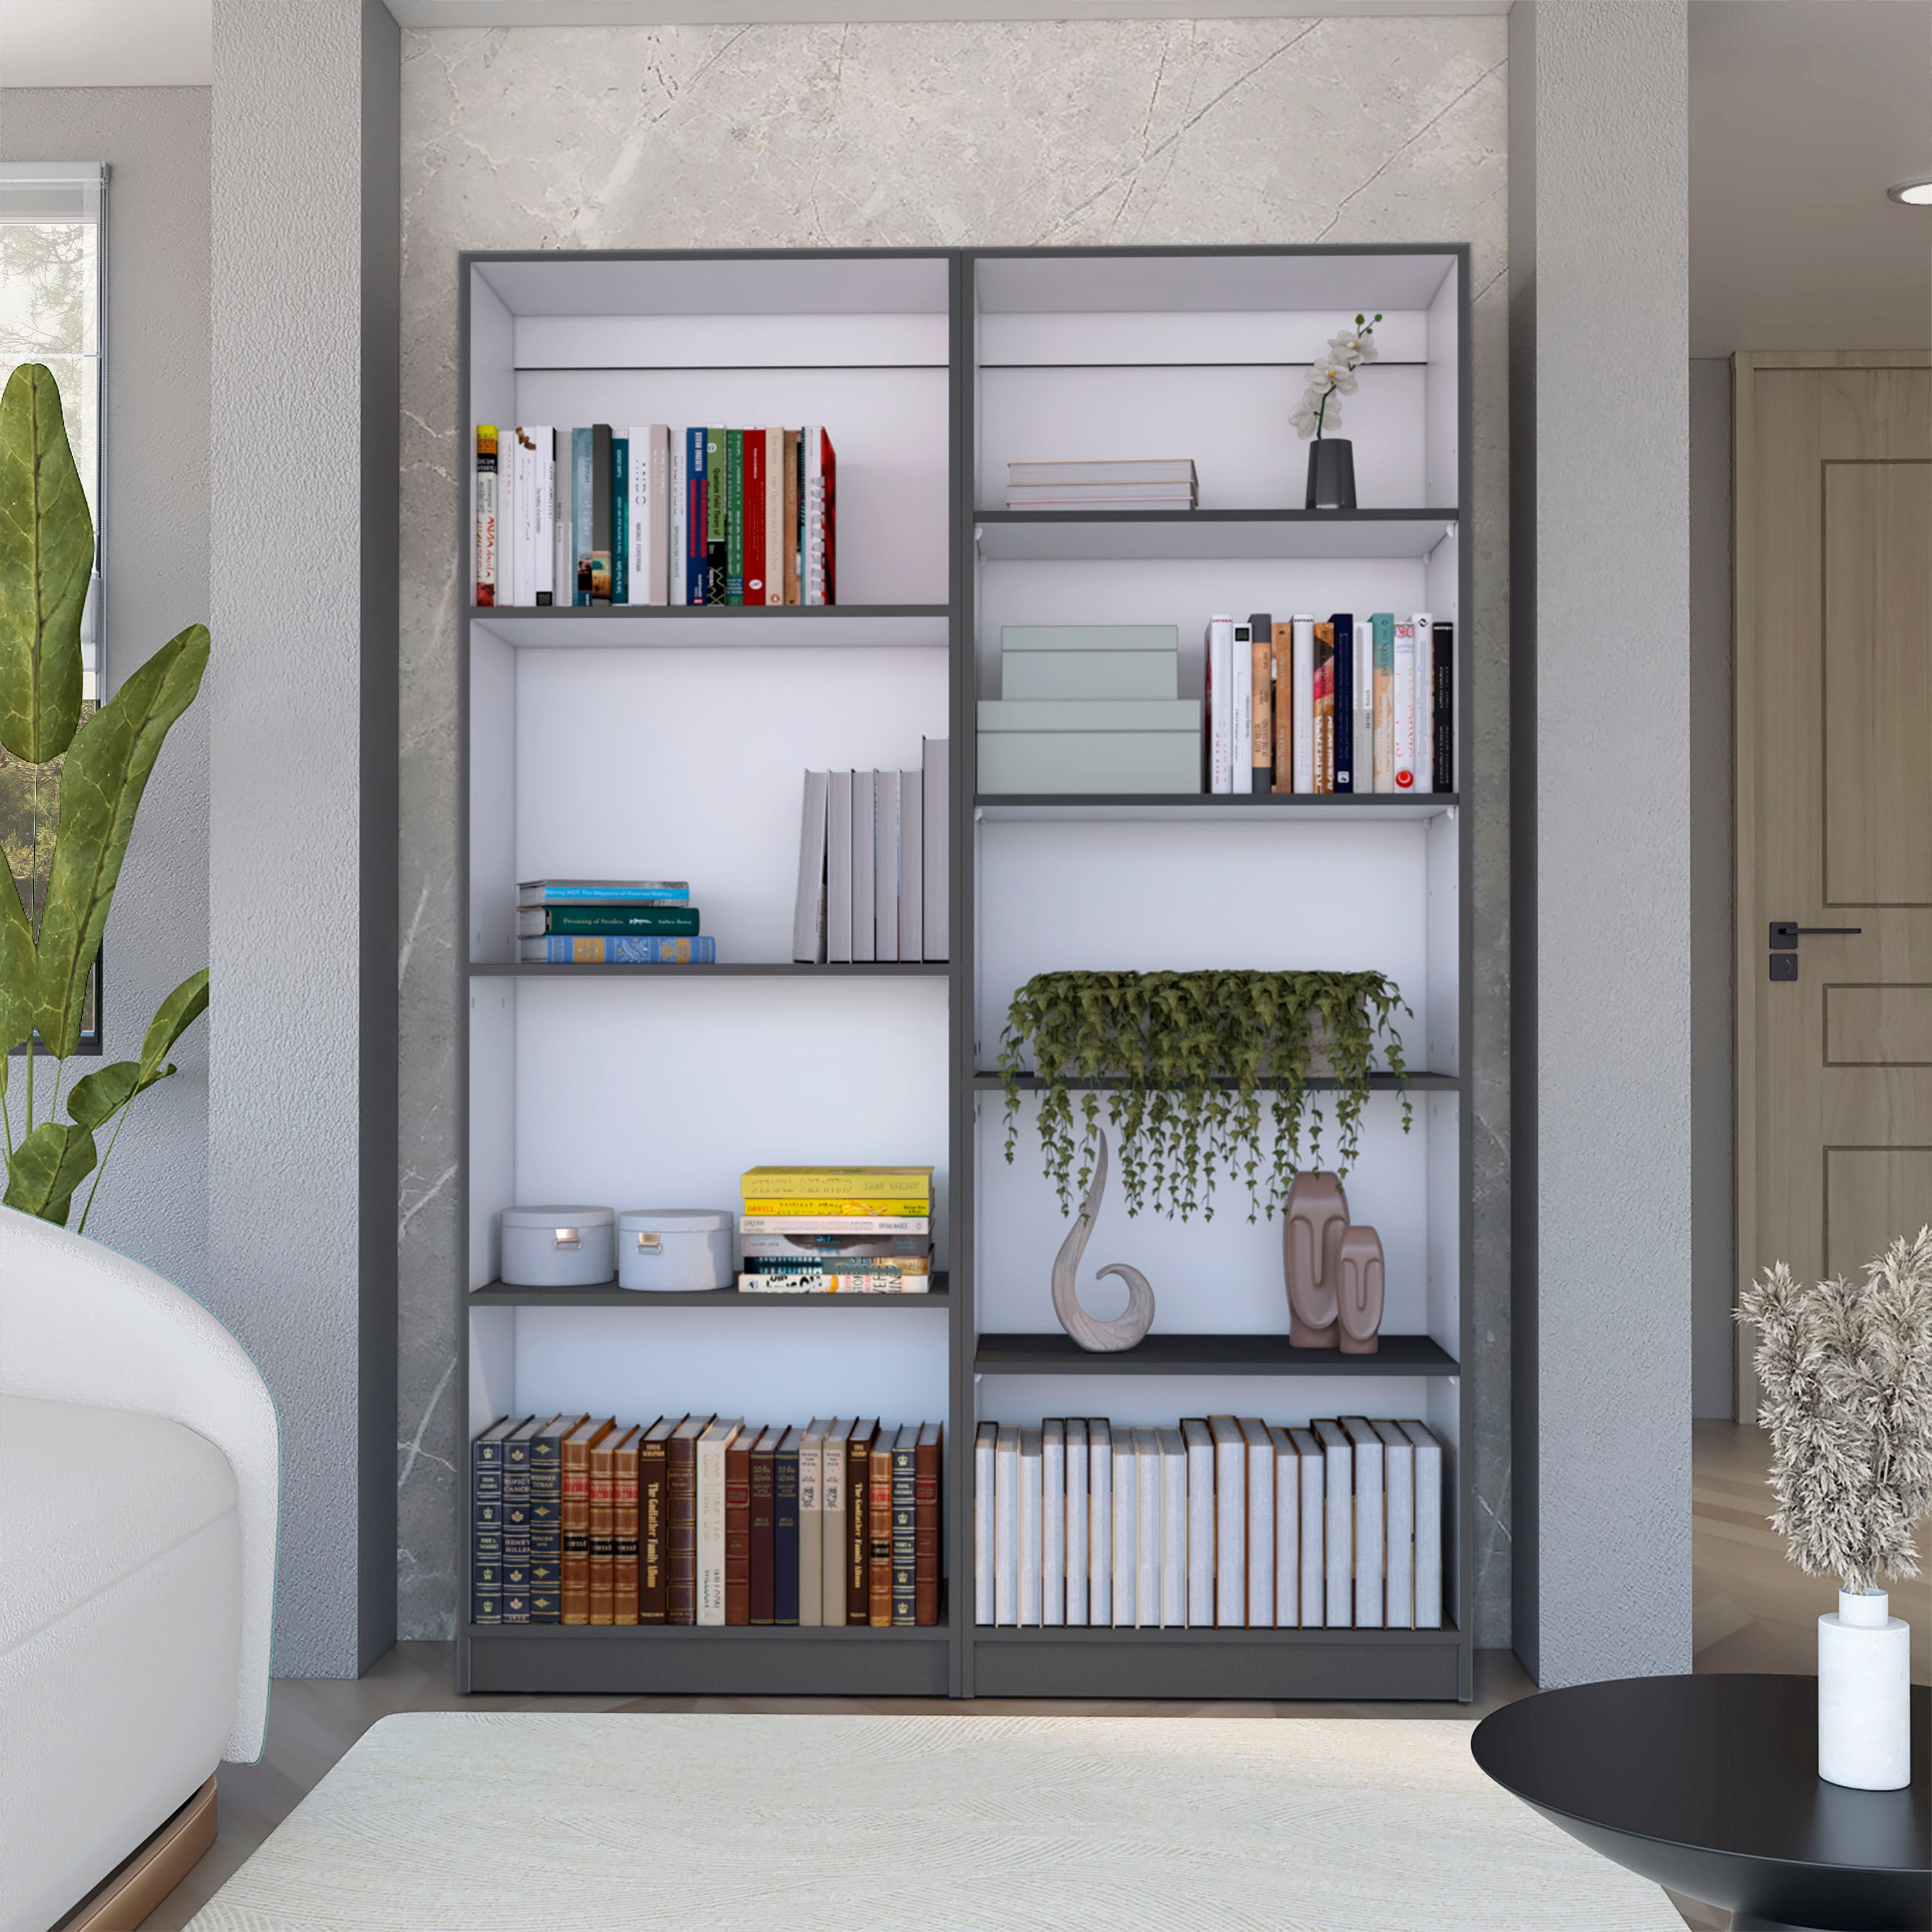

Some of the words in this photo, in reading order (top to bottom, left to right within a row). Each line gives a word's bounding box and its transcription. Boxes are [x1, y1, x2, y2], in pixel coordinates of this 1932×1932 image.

[712, 468, 721, 493] Quantum
[712, 510, 721, 528] Theory
[1396, 626, 1414, 638] DK
[648, 1482, 659, 1498] The
[855, 1482, 863, 1498] The
[648, 1499, 659, 1537] Godfather
[855, 1499, 863, 1537] Godfather
[647, 1539, 659, 1563] Family
[648, 1565, 659, 1588] Album
